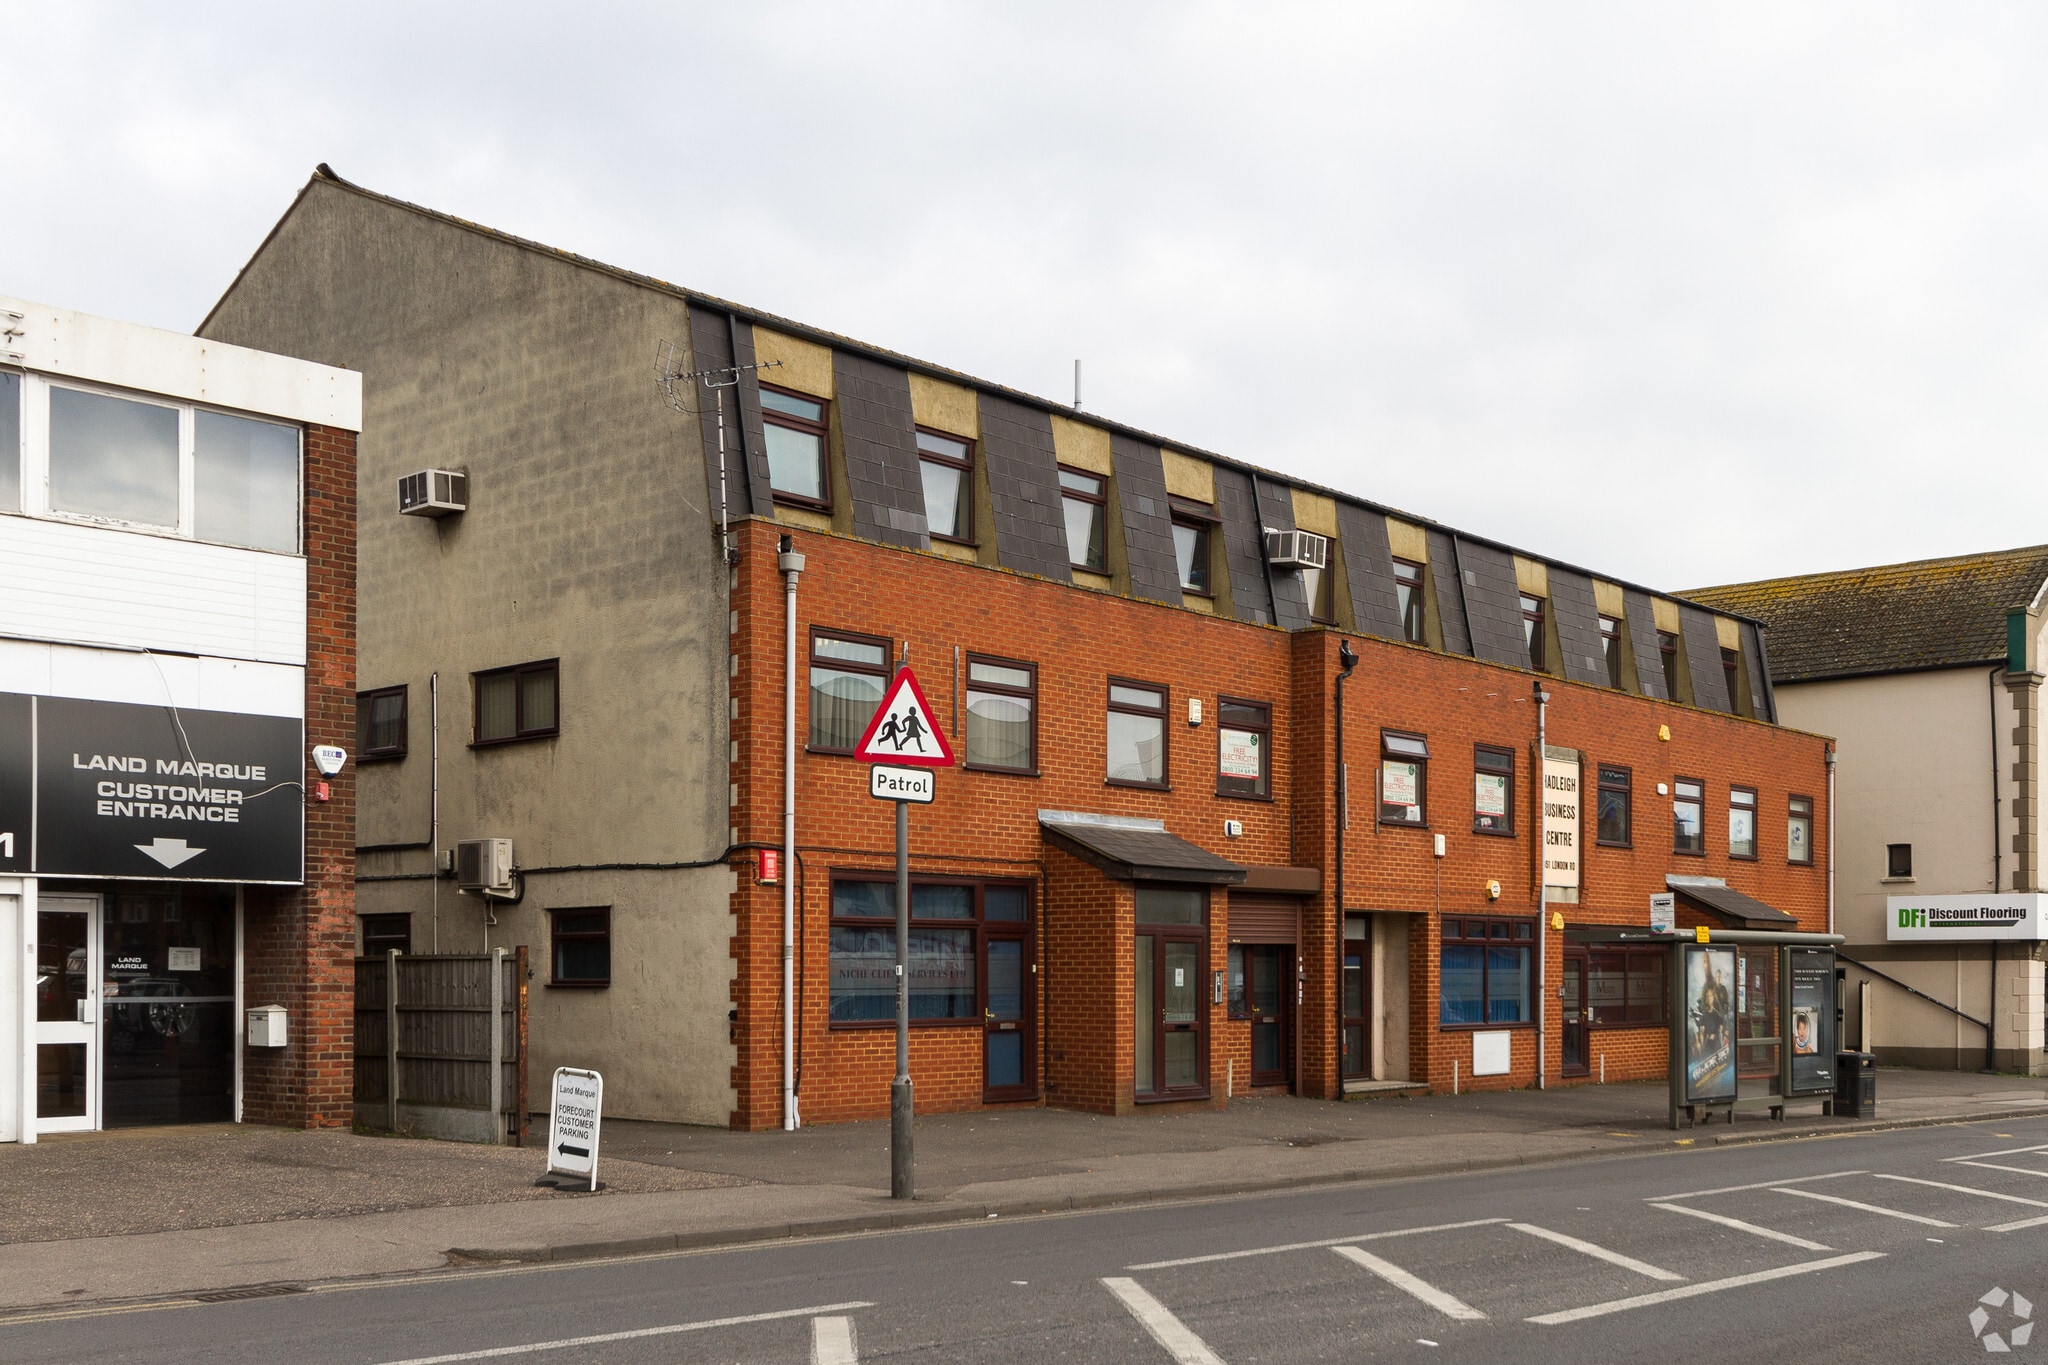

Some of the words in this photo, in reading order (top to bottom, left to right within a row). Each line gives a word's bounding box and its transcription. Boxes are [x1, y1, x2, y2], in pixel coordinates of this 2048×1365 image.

[1221, 753, 1258, 763] ELECTRICITY!
[1233, 747, 1246, 755] FREE
[73, 753, 147, 774] LAND
[156, 759, 267, 782] MARQUE
[877, 773, 928, 794] Patrol
[97, 781, 243, 805] CUSTOMER
[97, 800, 240, 823] ENTRANCE
[1545, 830, 1573, 847] CENTRE
[1552, 860, 1569, 870] LONDON
[1569, 862, 1576, 871] RD
[1898, 908, 1926, 928] DFi
[1929, 907, 1978, 920] Discount
[1980, 906, 2027, 920] Flooring
[839, 968, 872, 979] NICHE
[560, 1084, 574, 1095] Land
[574, 1086, 596, 1099] Marque
[559, 1104, 595, 1118] FORECOURT
[557, 1115, 595, 1130] CUSTOMER
[559, 1126, 589, 1140] PARKING
